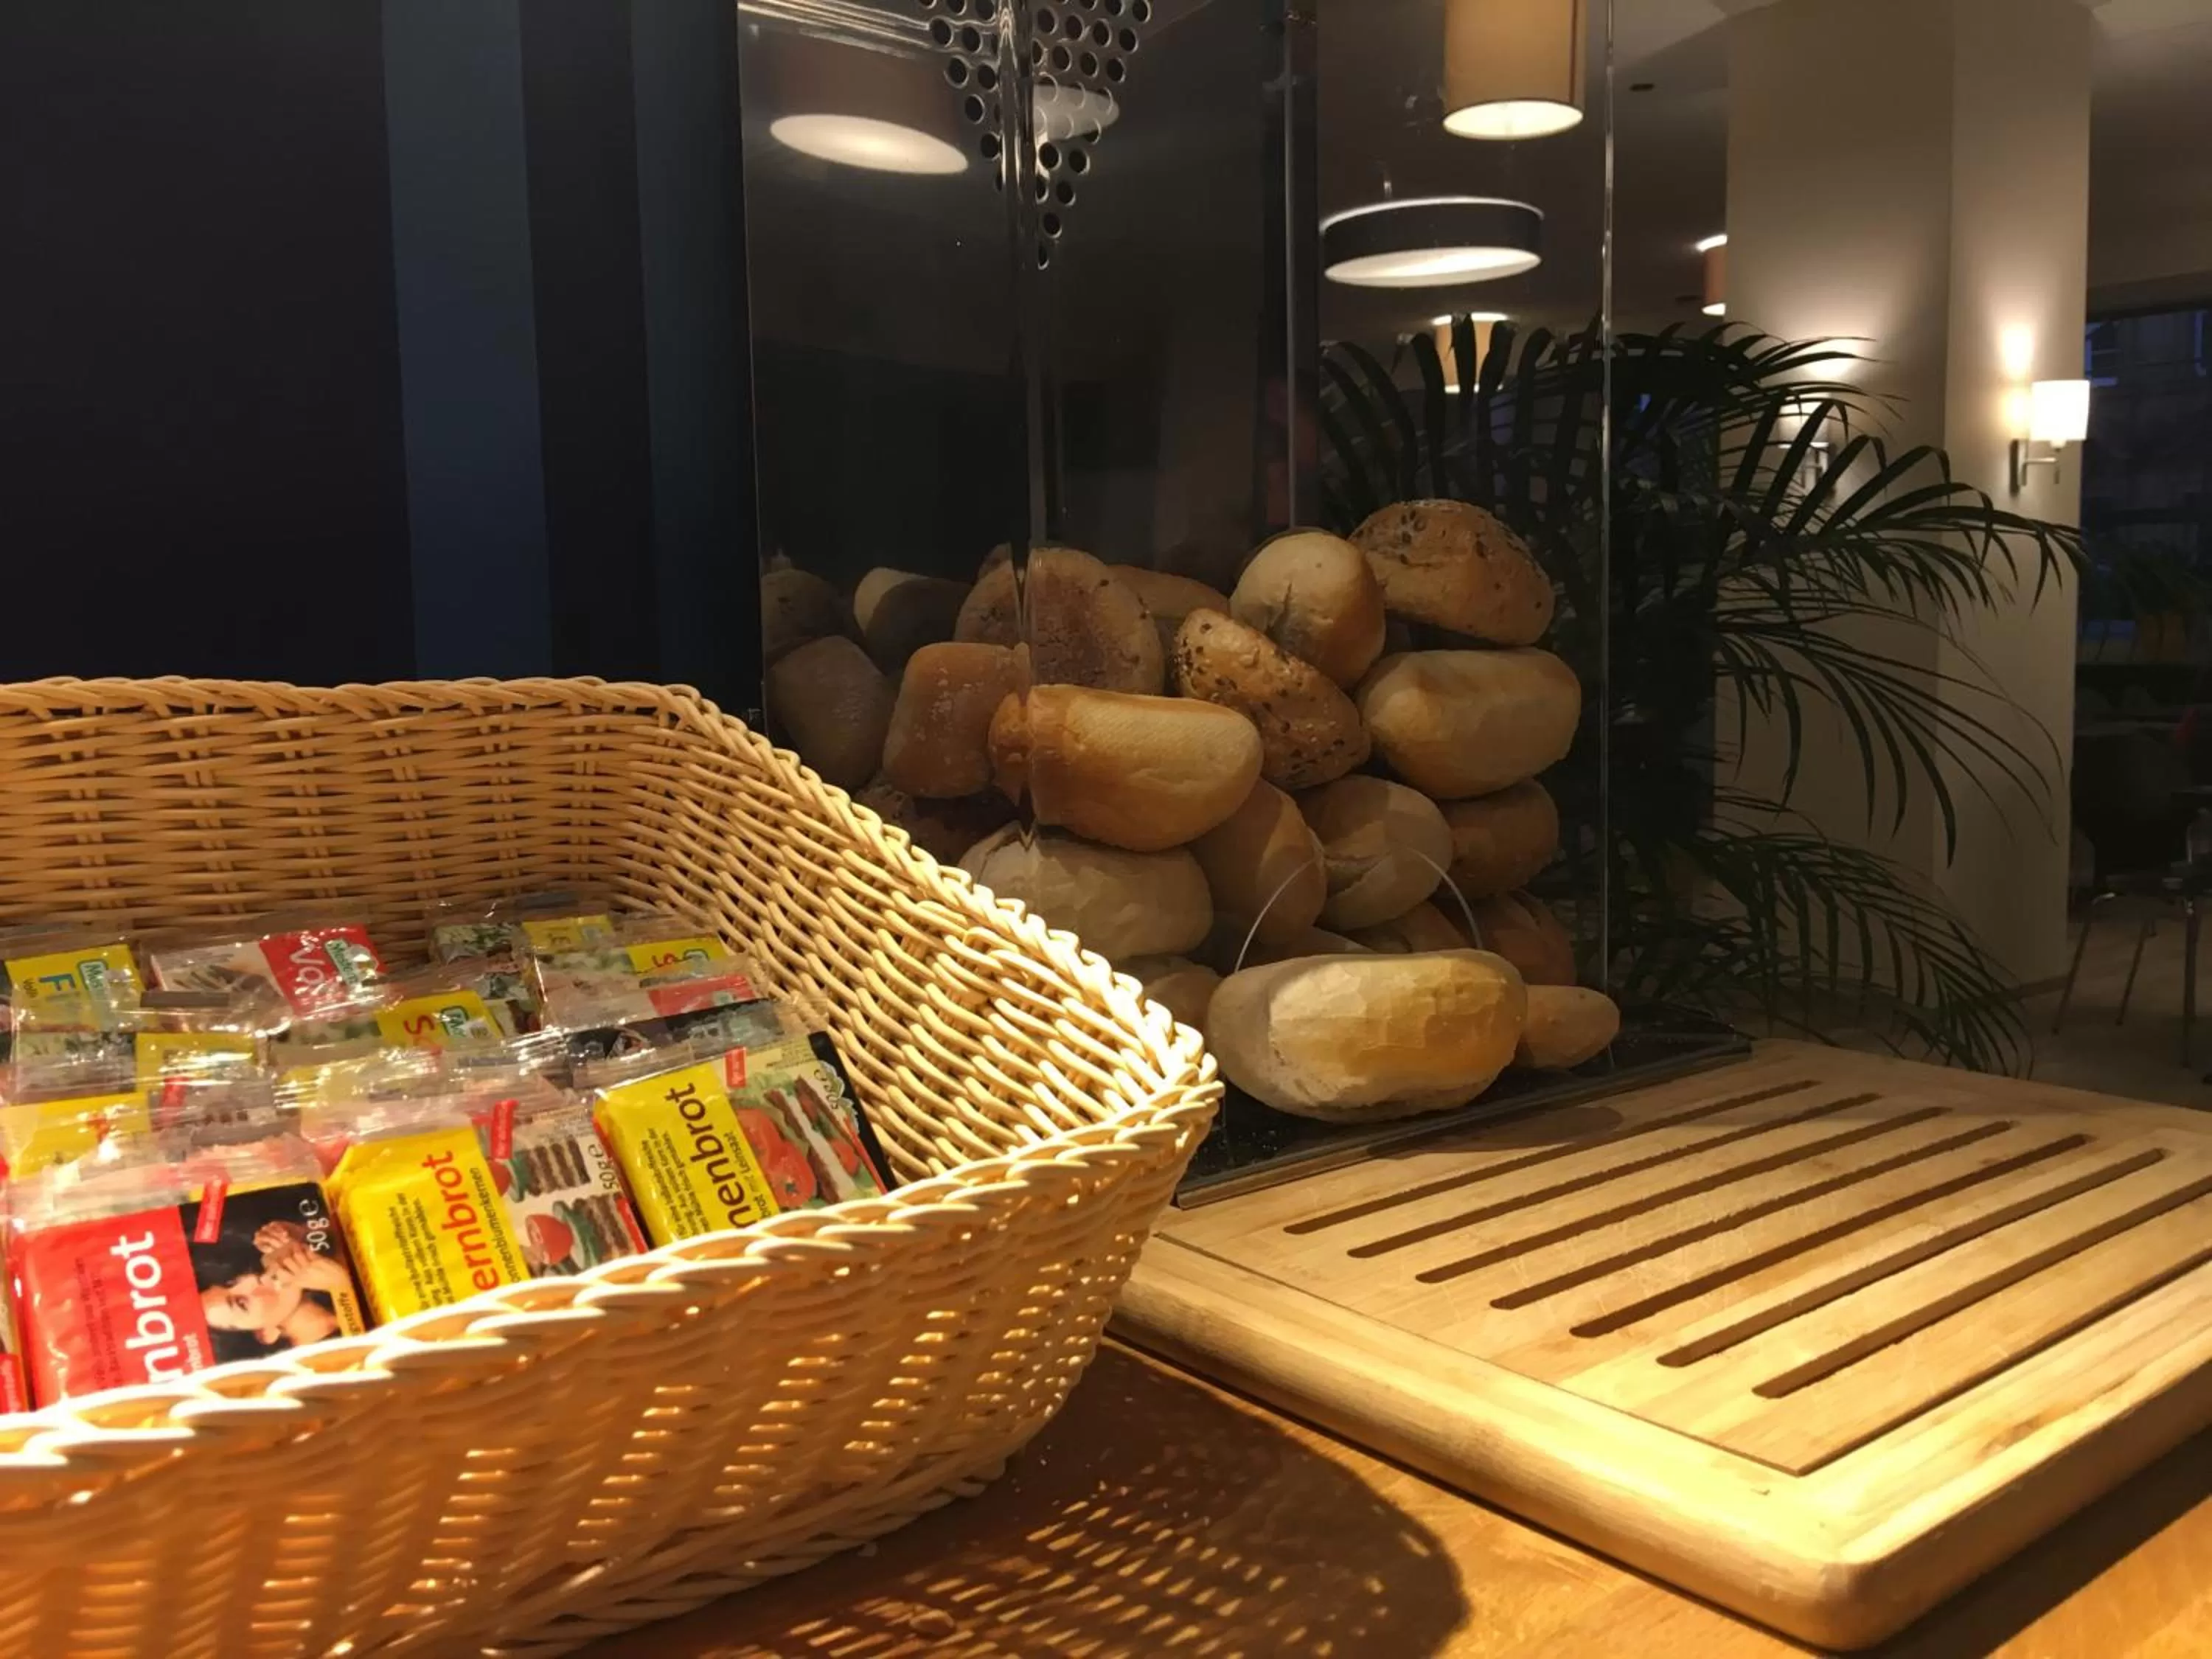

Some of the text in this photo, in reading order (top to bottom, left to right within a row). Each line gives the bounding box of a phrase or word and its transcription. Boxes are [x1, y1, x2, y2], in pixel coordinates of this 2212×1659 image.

[422, 1150, 500, 1291] ernbrot
[664, 1082, 759, 1229] nenbrot
[109, 1231, 184, 1384] nbrot
